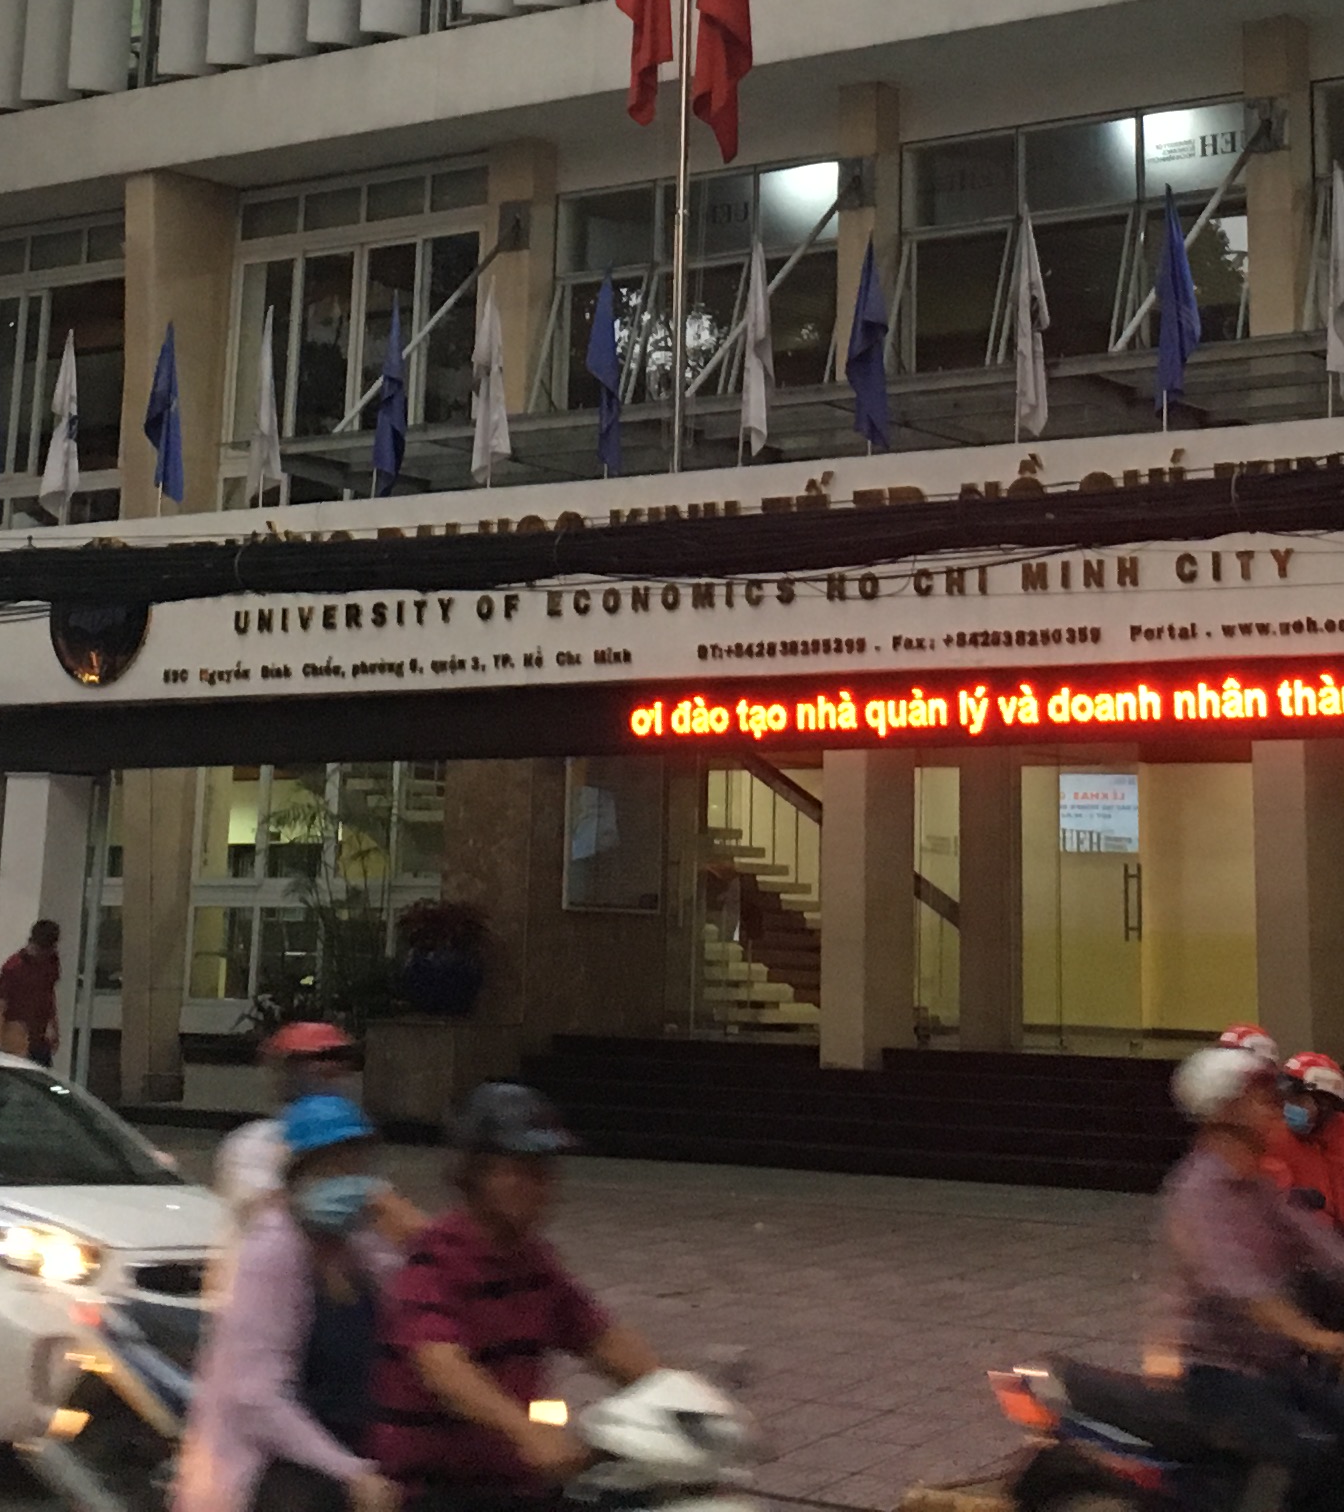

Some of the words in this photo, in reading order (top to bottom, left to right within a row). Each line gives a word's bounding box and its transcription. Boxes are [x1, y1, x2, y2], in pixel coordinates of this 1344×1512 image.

[234, 596, 453, 634] UNIVERSITY
[476, 594, 519, 620] OF
[546, 577, 796, 616] ECONOMICS
[826, 572, 880, 600] HO
[913, 566, 989, 596] CHI
[1022, 556, 1139, 591] MINH
[1175, 548, 1294, 583] CITY
[1130, 622, 1198, 642] Portal
[670, 697, 729, 734] đào
[736, 698, 787, 739] tạo
[796, 691, 858, 730] nhà
[865, 688, 948, 737] quản
[959, 685, 987, 735] lý
[998, 683, 1040, 726] và
[1048, 685, 1161, 724] doanh
[1174, 678, 1268, 720] nhân
